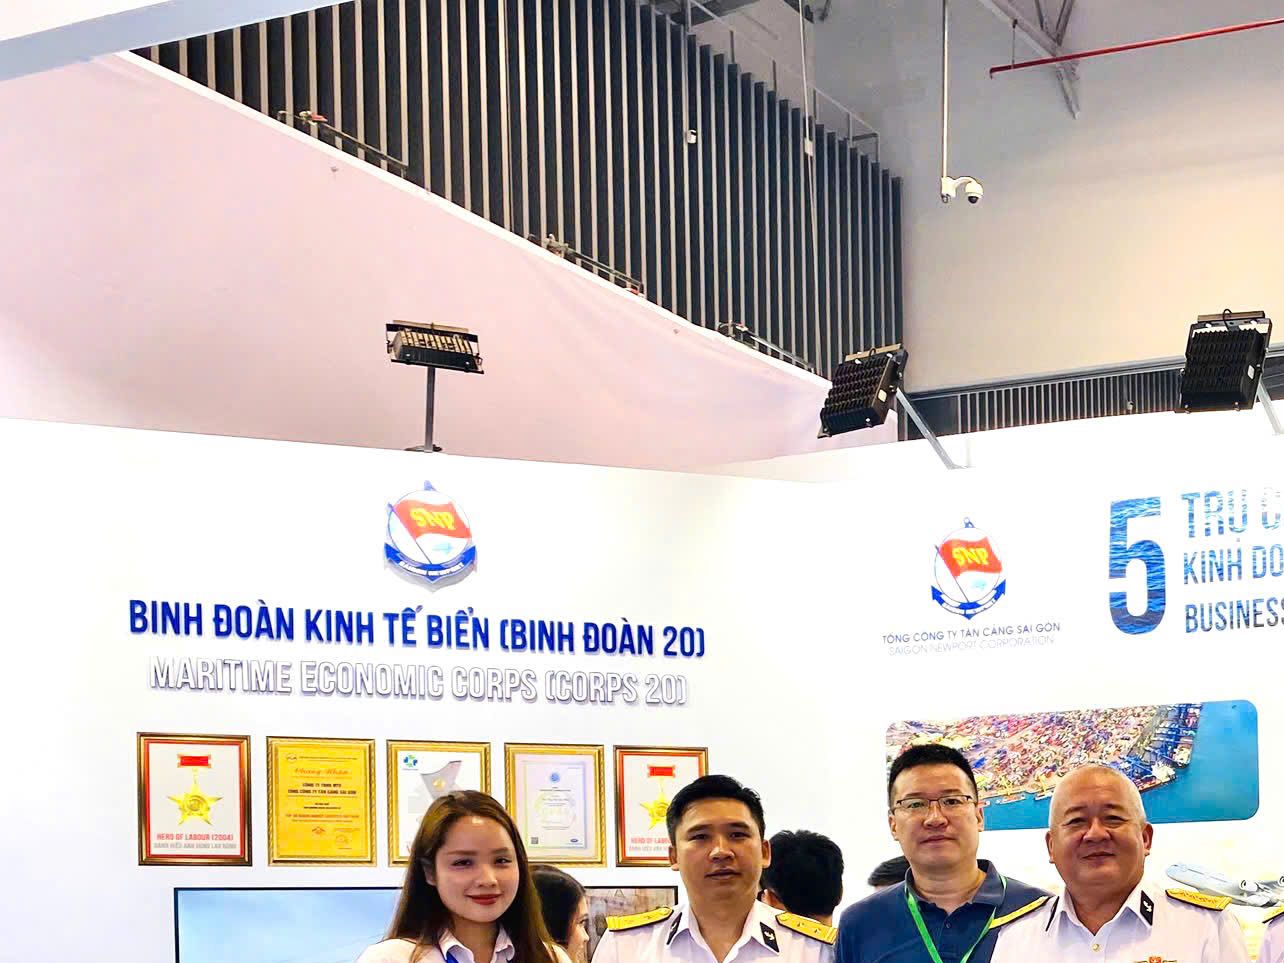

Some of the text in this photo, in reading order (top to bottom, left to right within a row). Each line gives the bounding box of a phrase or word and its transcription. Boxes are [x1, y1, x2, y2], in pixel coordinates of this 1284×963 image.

[952, 546, 989, 567] SNP
[1109, 496, 1166, 635] 5
[1184, 547, 1242, 585] KINH
[129, 599, 705, 658] BINH ĐOÀN KINH TẾ BIỂN (BINH ĐOÀN 20)
[947, 630, 958, 640] TY
[150, 656, 688, 706] MARITIME ECONOMIC CORPS (CORPS 20)
